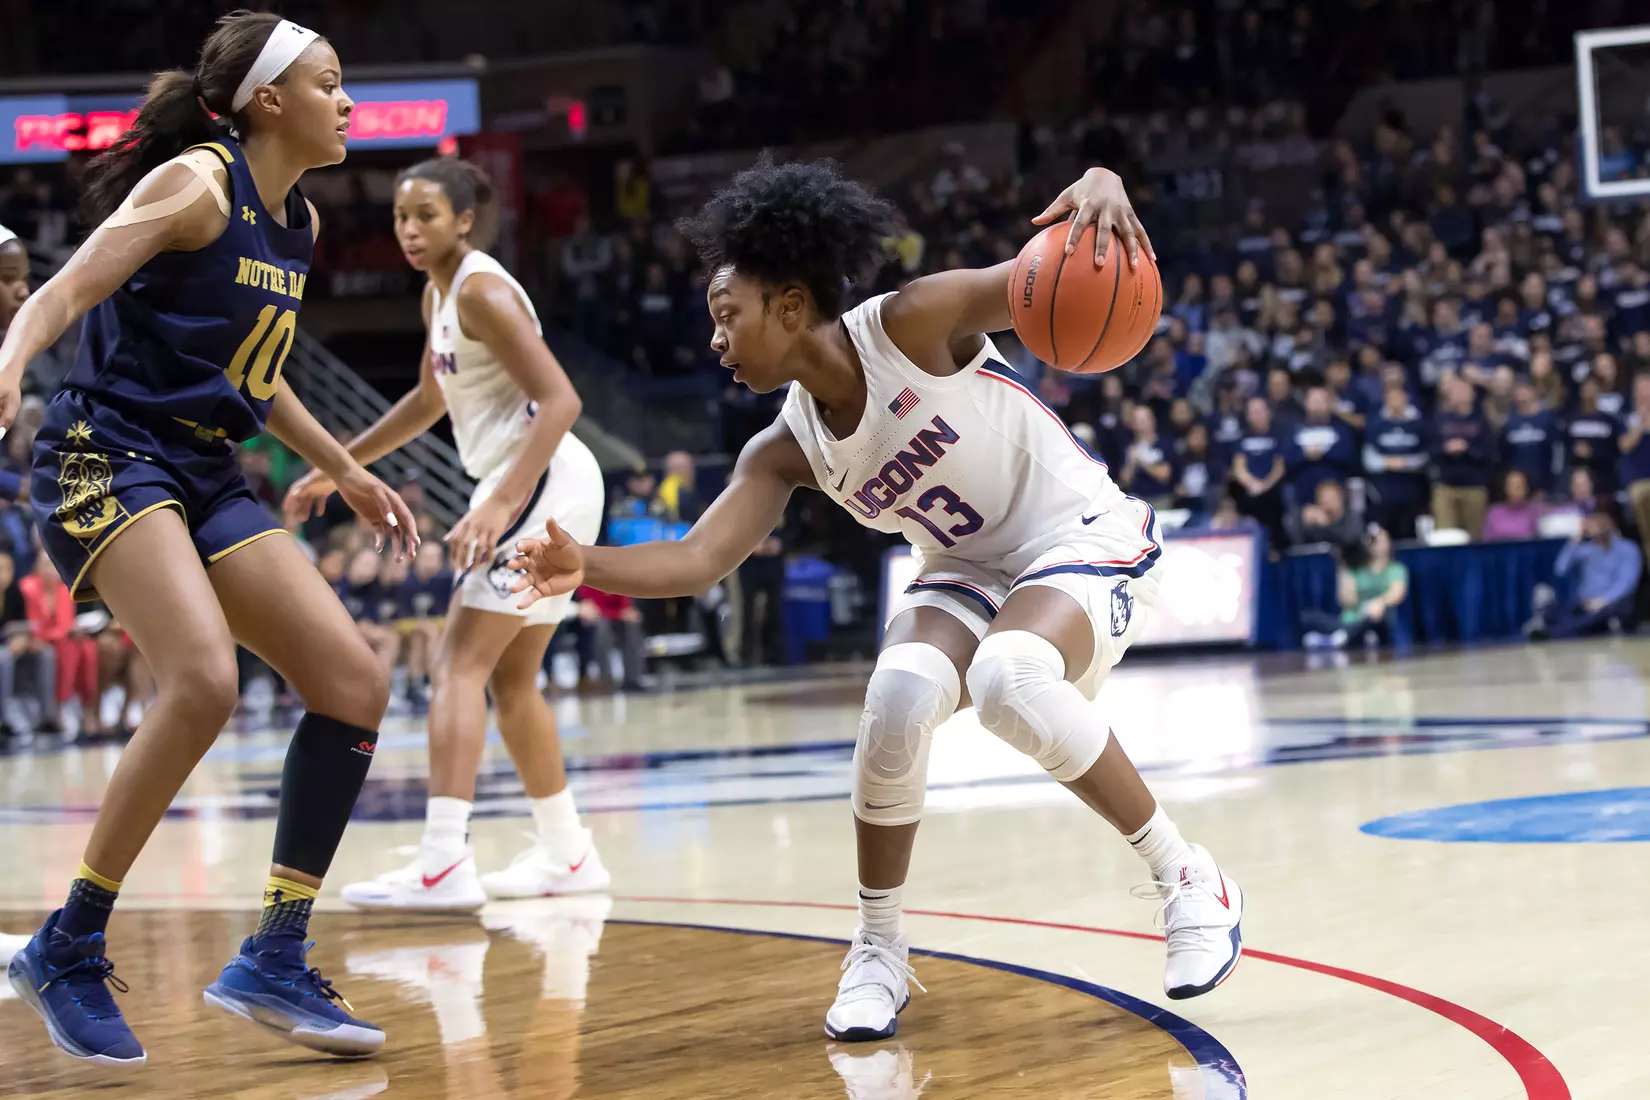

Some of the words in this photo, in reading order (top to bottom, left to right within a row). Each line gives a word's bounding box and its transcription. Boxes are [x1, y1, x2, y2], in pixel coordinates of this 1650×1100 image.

[235, 256, 287, 295] NOTRE
[288, 270, 307, 300] DA
[1023, 255, 1043, 308] UCONN
[224, 304, 296, 401] 10
[844, 414, 961, 519] UCONN
[894, 484, 985, 549] 13
